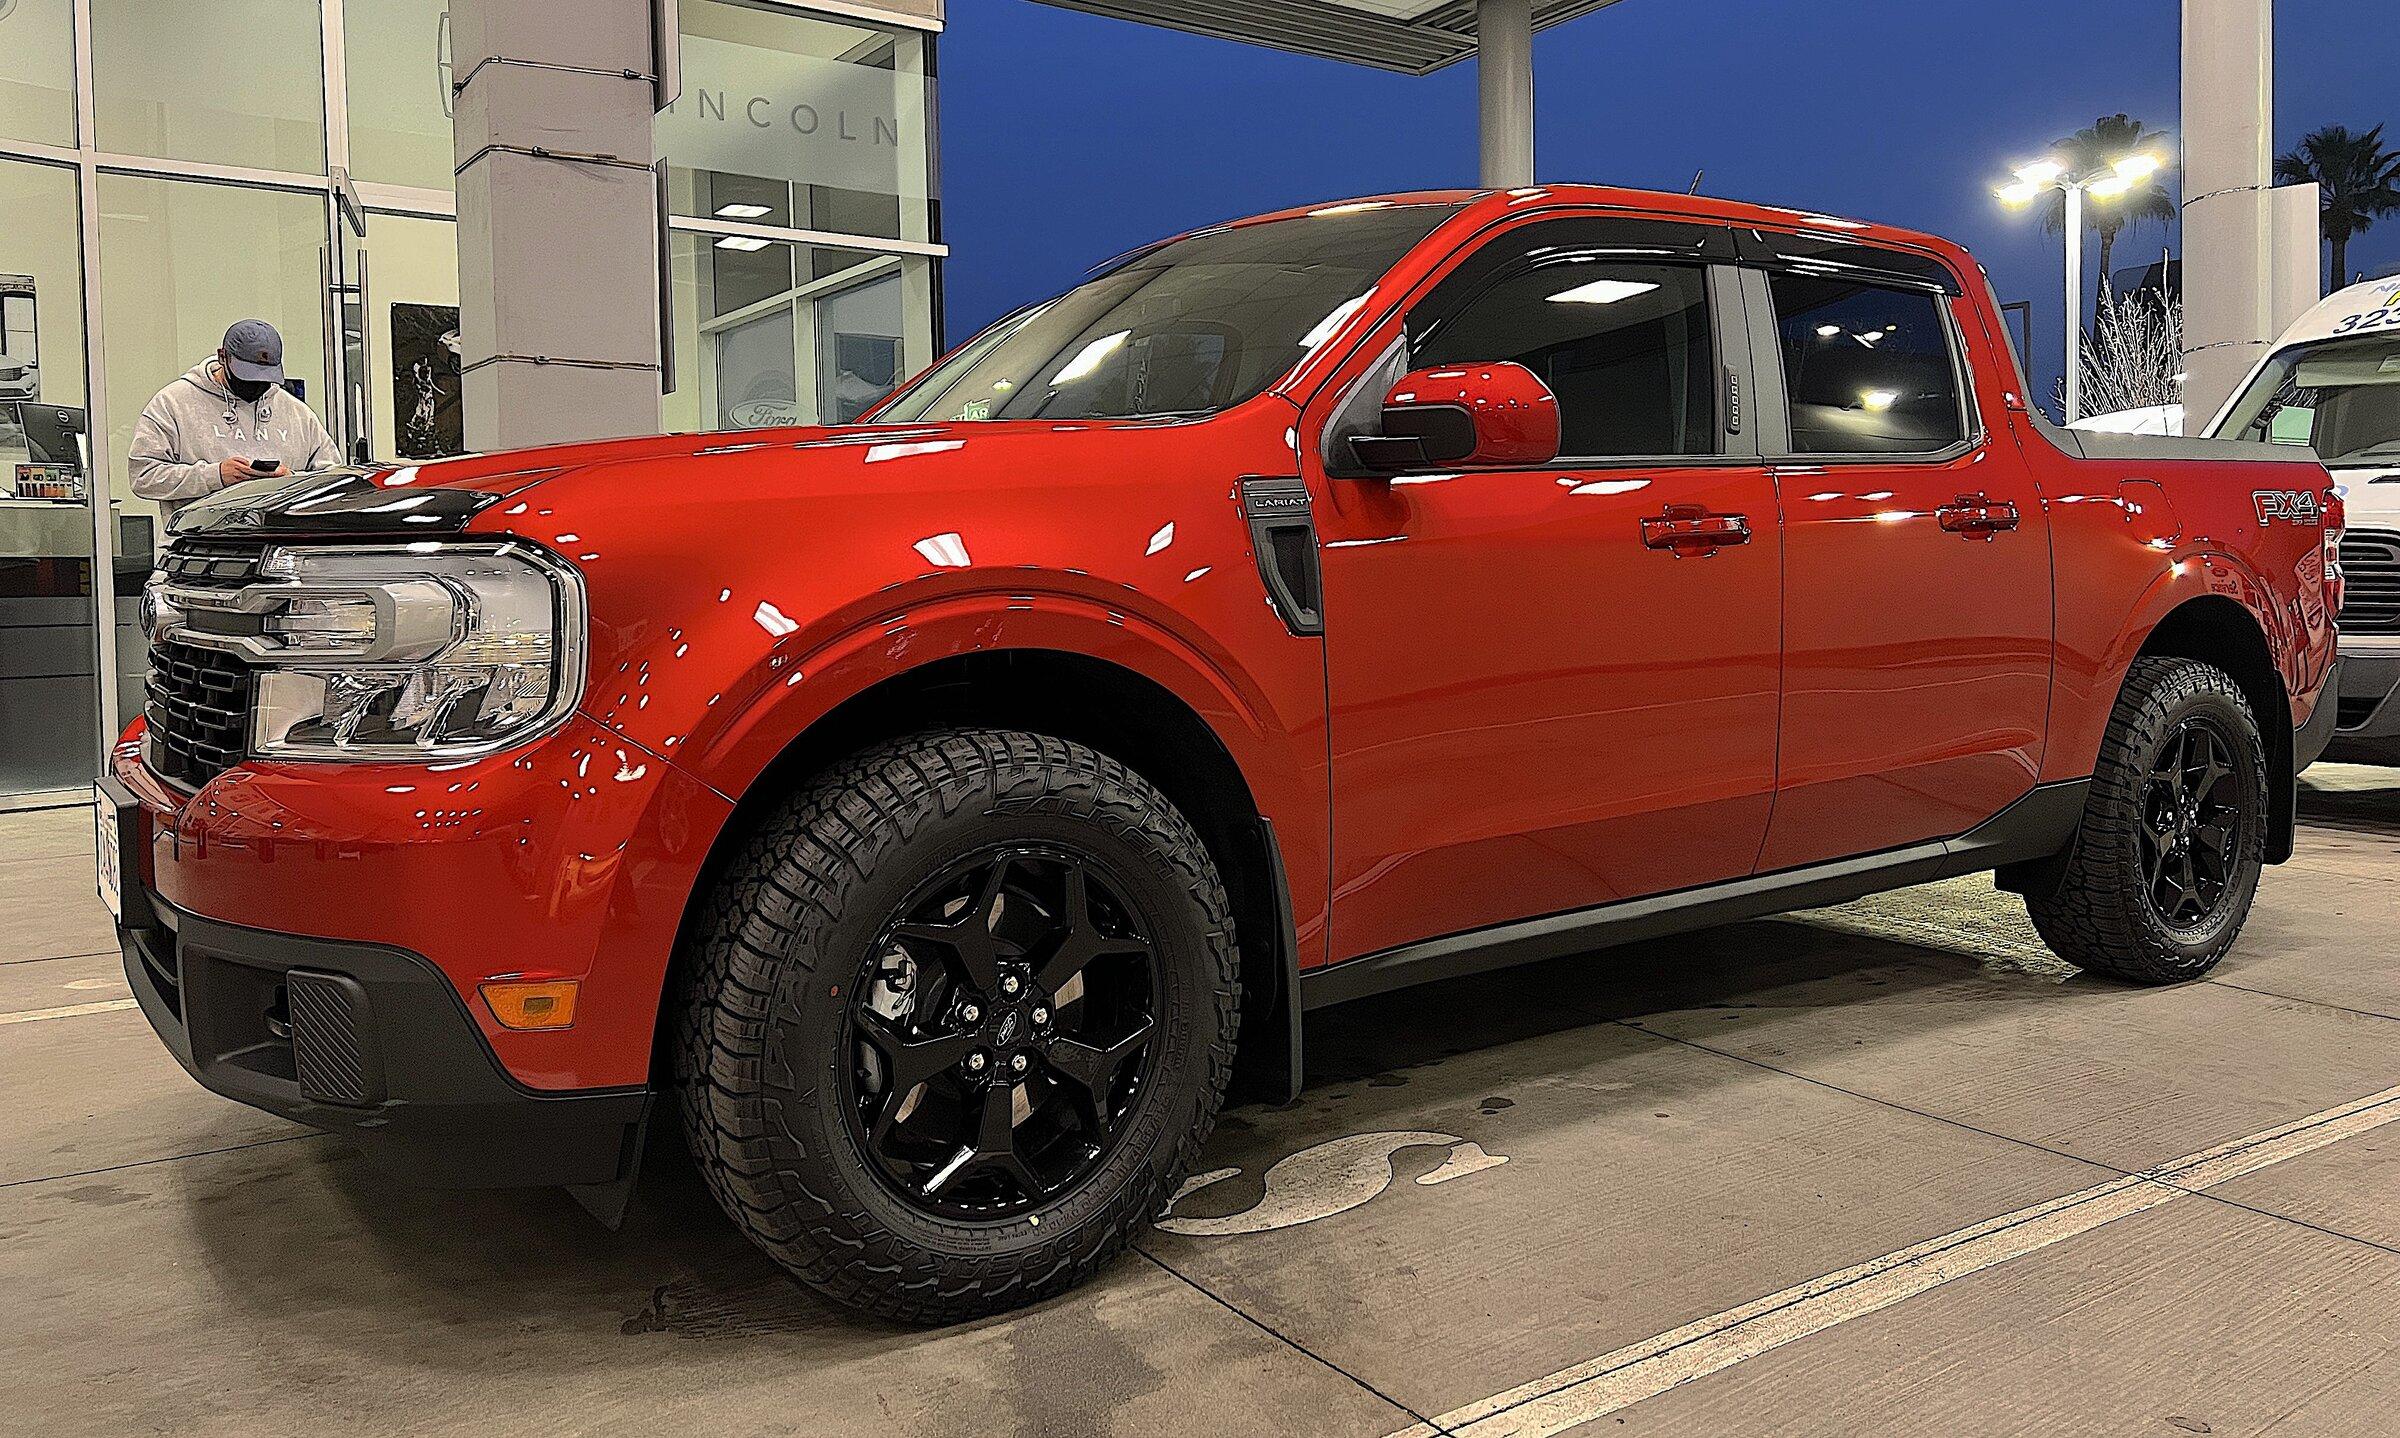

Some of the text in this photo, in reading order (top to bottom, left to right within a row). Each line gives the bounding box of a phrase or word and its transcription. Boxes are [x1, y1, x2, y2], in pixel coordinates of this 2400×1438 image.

[213, 424, 288, 442] LANY
[1254, 498, 1307, 508] LARIAT
[2252, 490, 2319, 526] FX4
[983, 795, 1177, 880] FALKEN
